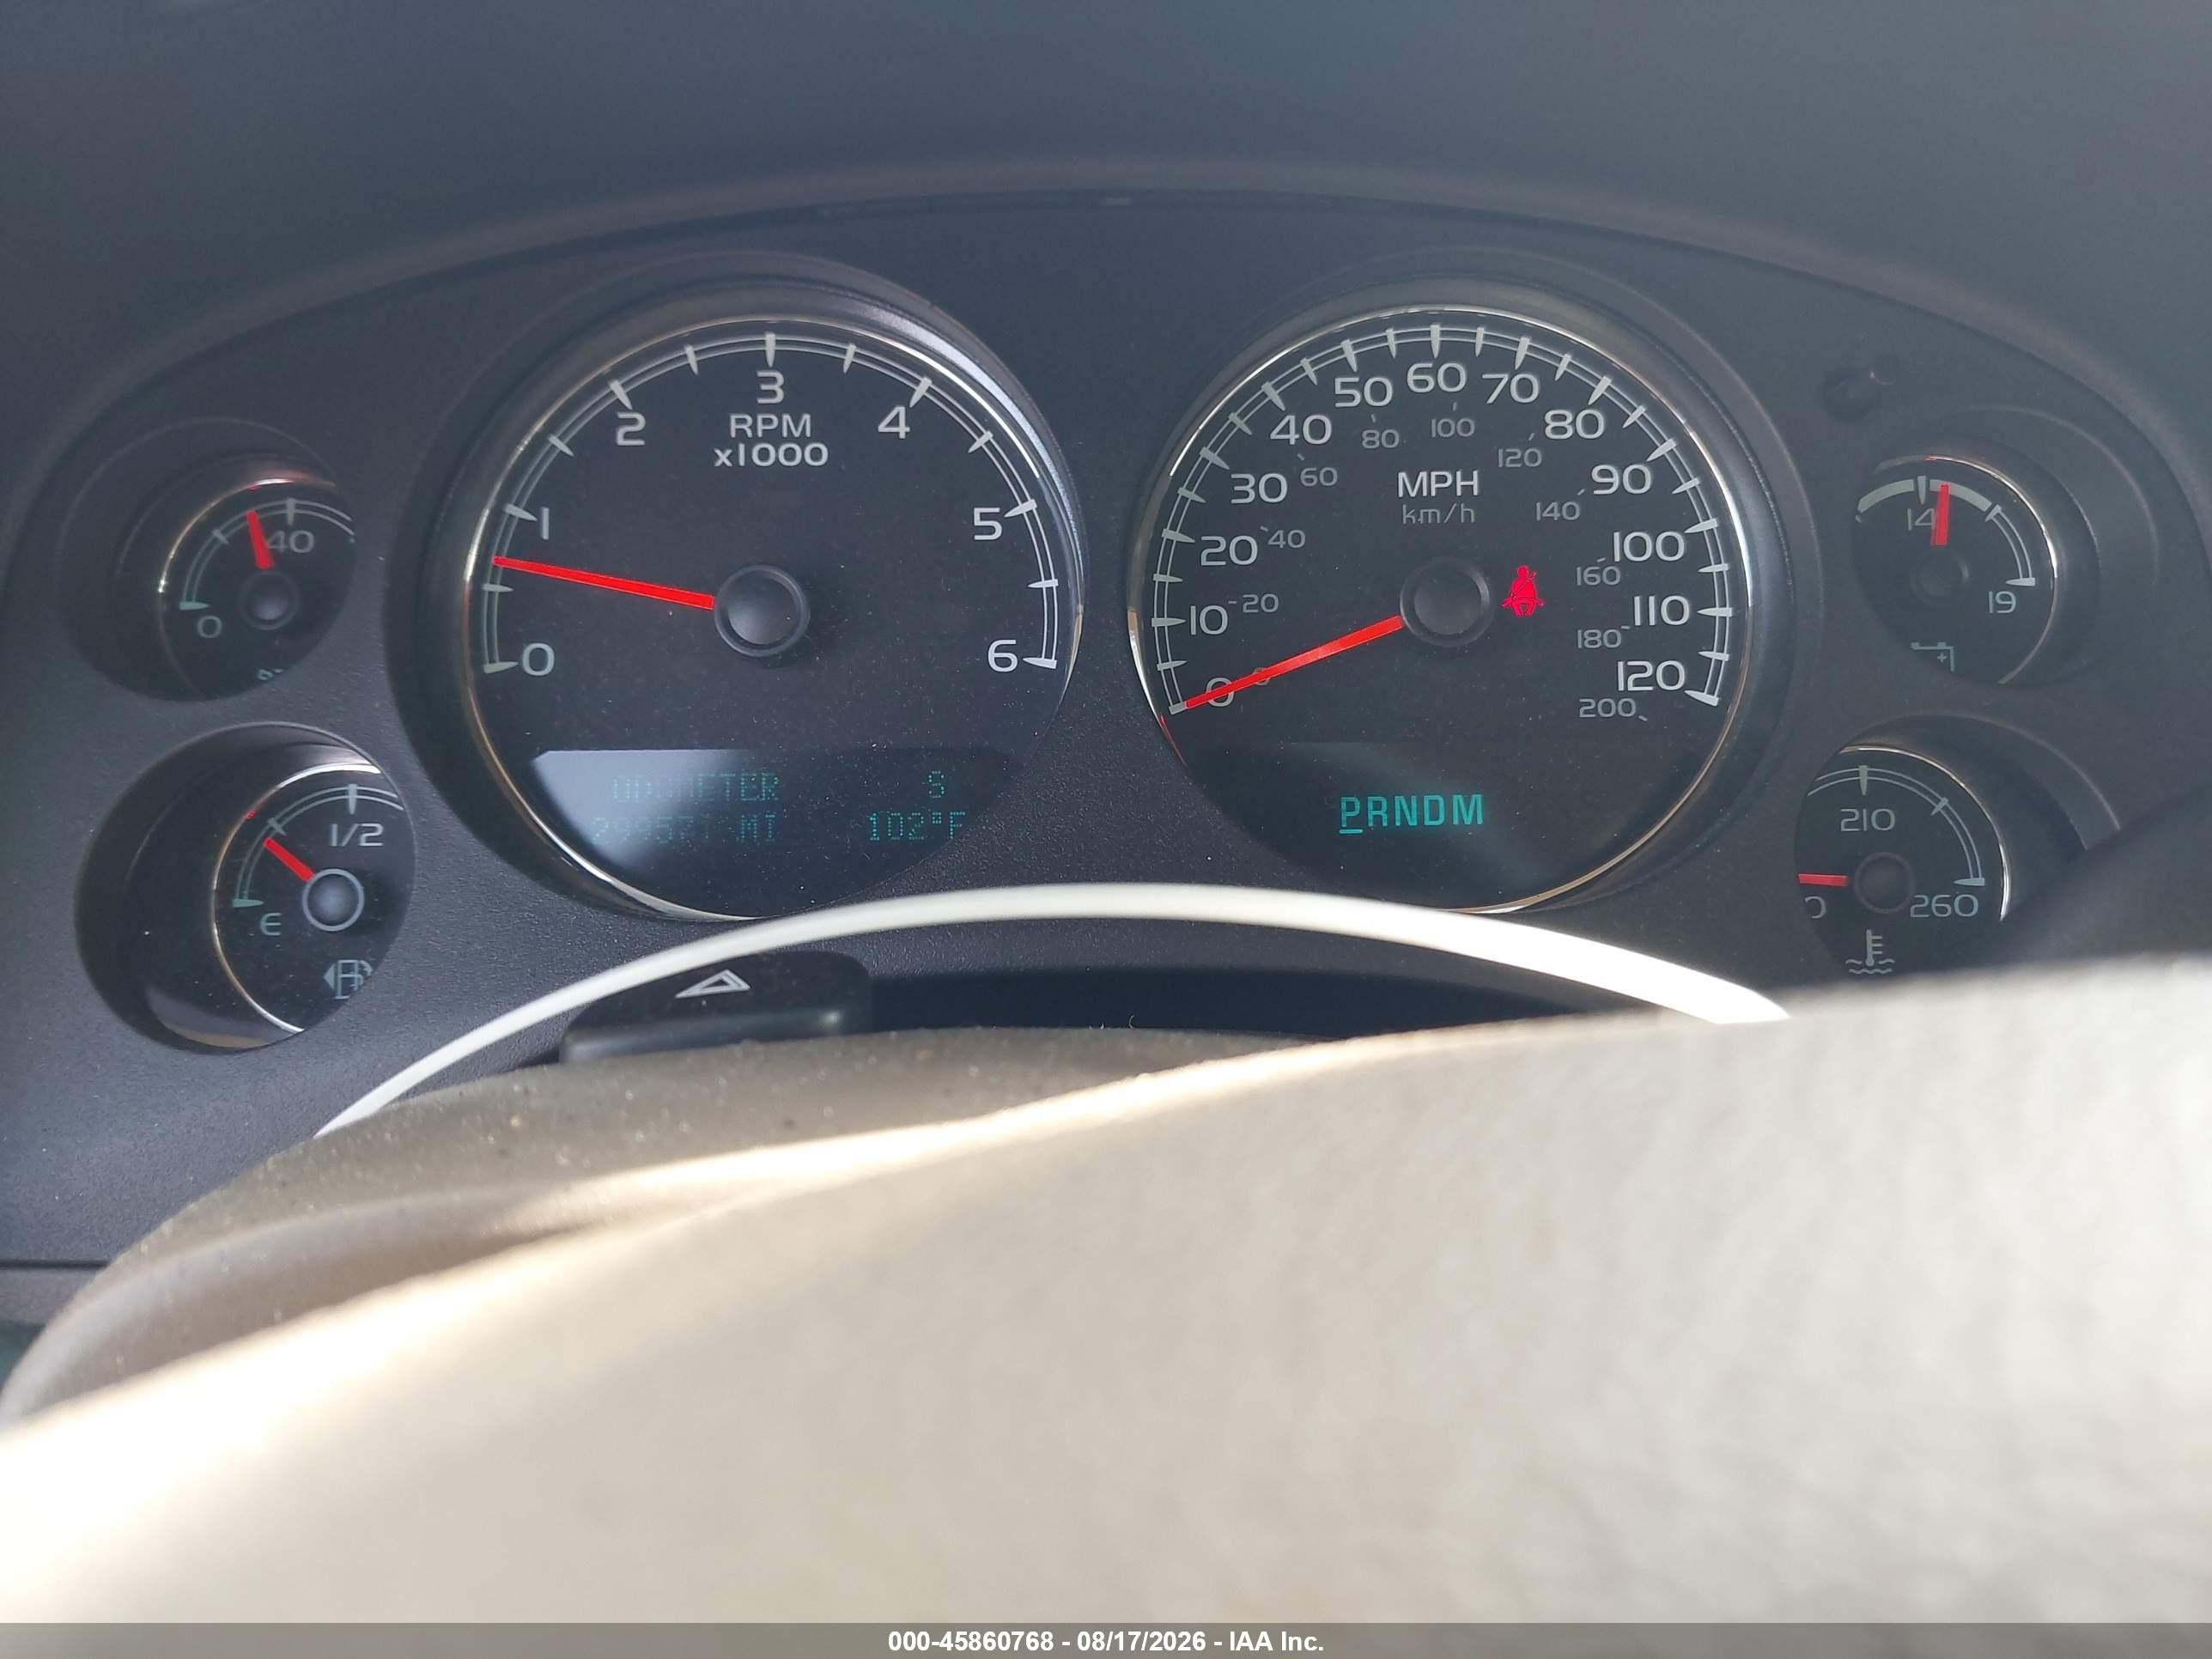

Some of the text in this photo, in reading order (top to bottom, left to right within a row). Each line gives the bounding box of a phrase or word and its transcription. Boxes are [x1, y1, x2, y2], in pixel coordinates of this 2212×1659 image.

[757, 370, 785, 404] 3
[1407, 362, 1467, 393] 60
[1482, 373, 1540, 404] 70
[1334, 376, 1394, 408] 50
[616, 411, 646, 446] 2
[730, 414, 811, 438] RPM
[878, 405, 910, 439] 4
[1270, 414, 1332, 445] 40
[1431, 417, 1475, 438] 100
[1544, 409, 1605, 440] 80
[1362, 429, 1400, 449] 80
[714, 443, 829, 467] x1000
[1498, 447, 1542, 468] 120
[1231, 472, 1288, 503] 30
[1300, 467, 1338, 487] 60
[1397, 471, 1480, 498] MPH
[1591, 464, 1652, 495] 90
[1401, 502, 1475, 525] km/h
[1535, 501, 1580, 521] 140
[1906, 508, 1936, 531] 14
[538, 507, 550, 540] 1
[973, 507, 1001, 540] 5
[266, 530, 314, 553] 40
[1200, 535, 1258, 566] 20
[1268, 528, 1306, 549] 40
[1613, 531, 1686, 562] 100
[1576, 566, 1621, 586] 160
[1243, 593, 1279, 613] 20
[1633, 595, 1690, 626] 110
[1988, 591, 2019, 614] 19
[197, 615, 223, 639] 0
[1189, 605, 1229, 635] 10
[1577, 629, 1622, 648] 180
[522, 642, 555, 676] 0
[988, 639, 1018, 672] 6
[1617, 660, 1686, 691] 120
[1579, 697, 1637, 718] 200
[1840, 808, 1896, 832] 210
[330, 823, 384, 847] 1/2
[1910, 894, 1978, 918] 260
[260, 913, 282, 936] E
